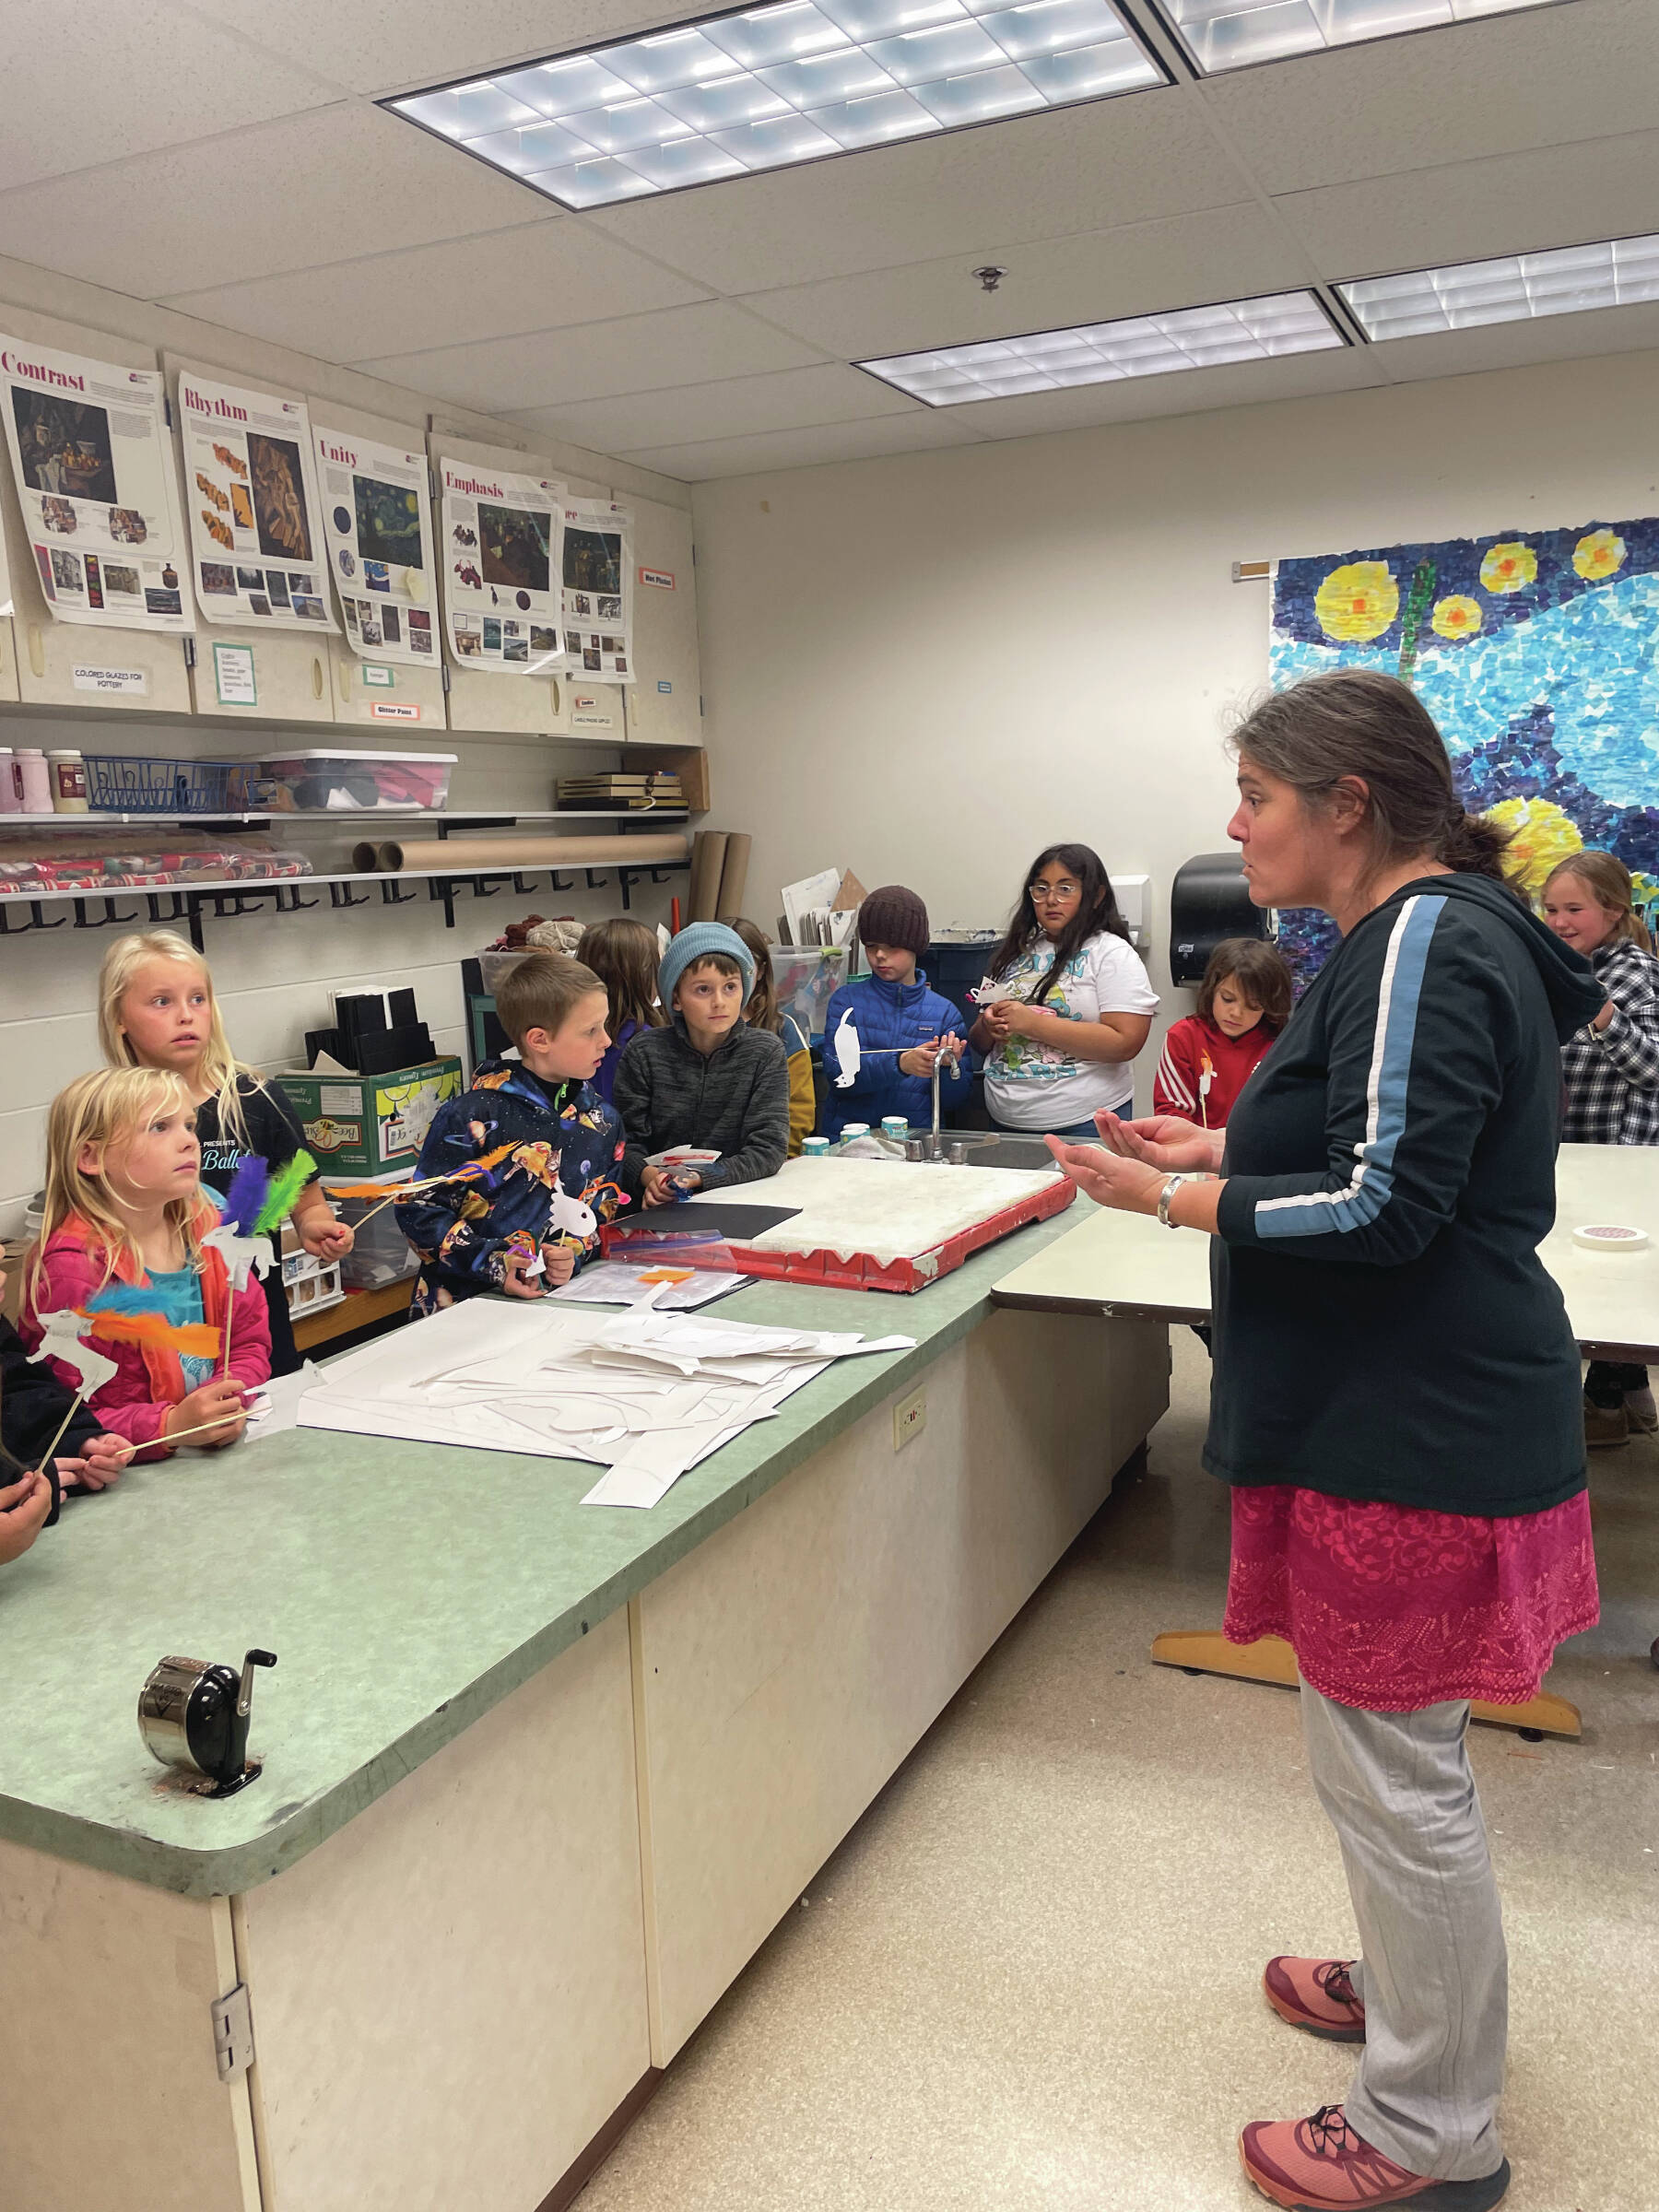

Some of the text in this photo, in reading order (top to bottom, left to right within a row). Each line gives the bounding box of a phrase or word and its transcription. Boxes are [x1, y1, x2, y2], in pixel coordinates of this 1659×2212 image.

[1, 351, 85, 392] Contrast
[184, 387, 248, 421] Rhythm
[320, 440, 359, 468] Unity
[446, 471, 504, 499] Emphasis
[75, 669, 105, 678] COLORED
[105, 671, 129, 680] GLAZES
[97, 680, 123, 688] POTTERY
